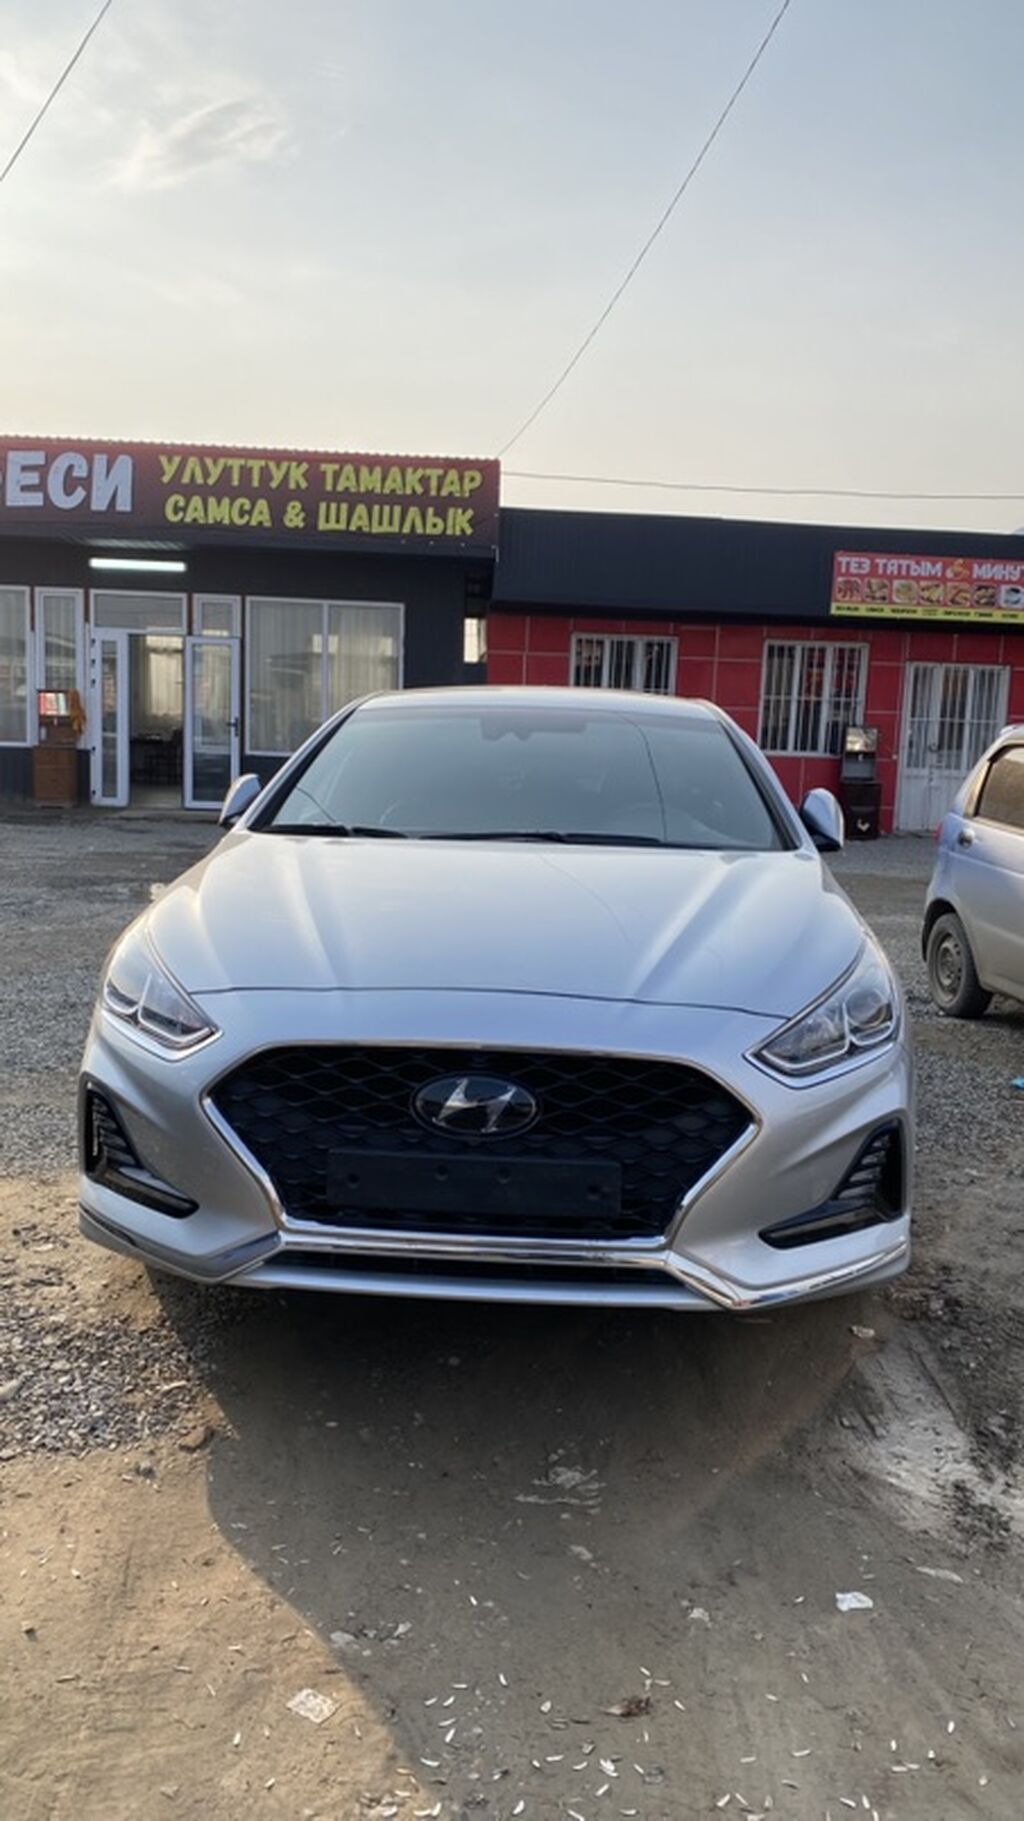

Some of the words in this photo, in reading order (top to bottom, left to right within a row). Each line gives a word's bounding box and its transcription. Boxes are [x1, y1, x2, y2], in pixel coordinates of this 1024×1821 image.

[0, 450, 133, 512] ЕСИ
[158, 454, 309, 490] УЛУТТУК
[320, 463, 483, 498] ТАМАКТАР
[164, 493, 272, 527] САМСА
[284, 500, 306, 529] &
[317, 501, 475, 536] ШАШЛЫК
[838, 557, 871, 574] ТЕЗ
[972, 563, 1024, 580] МИНУ
